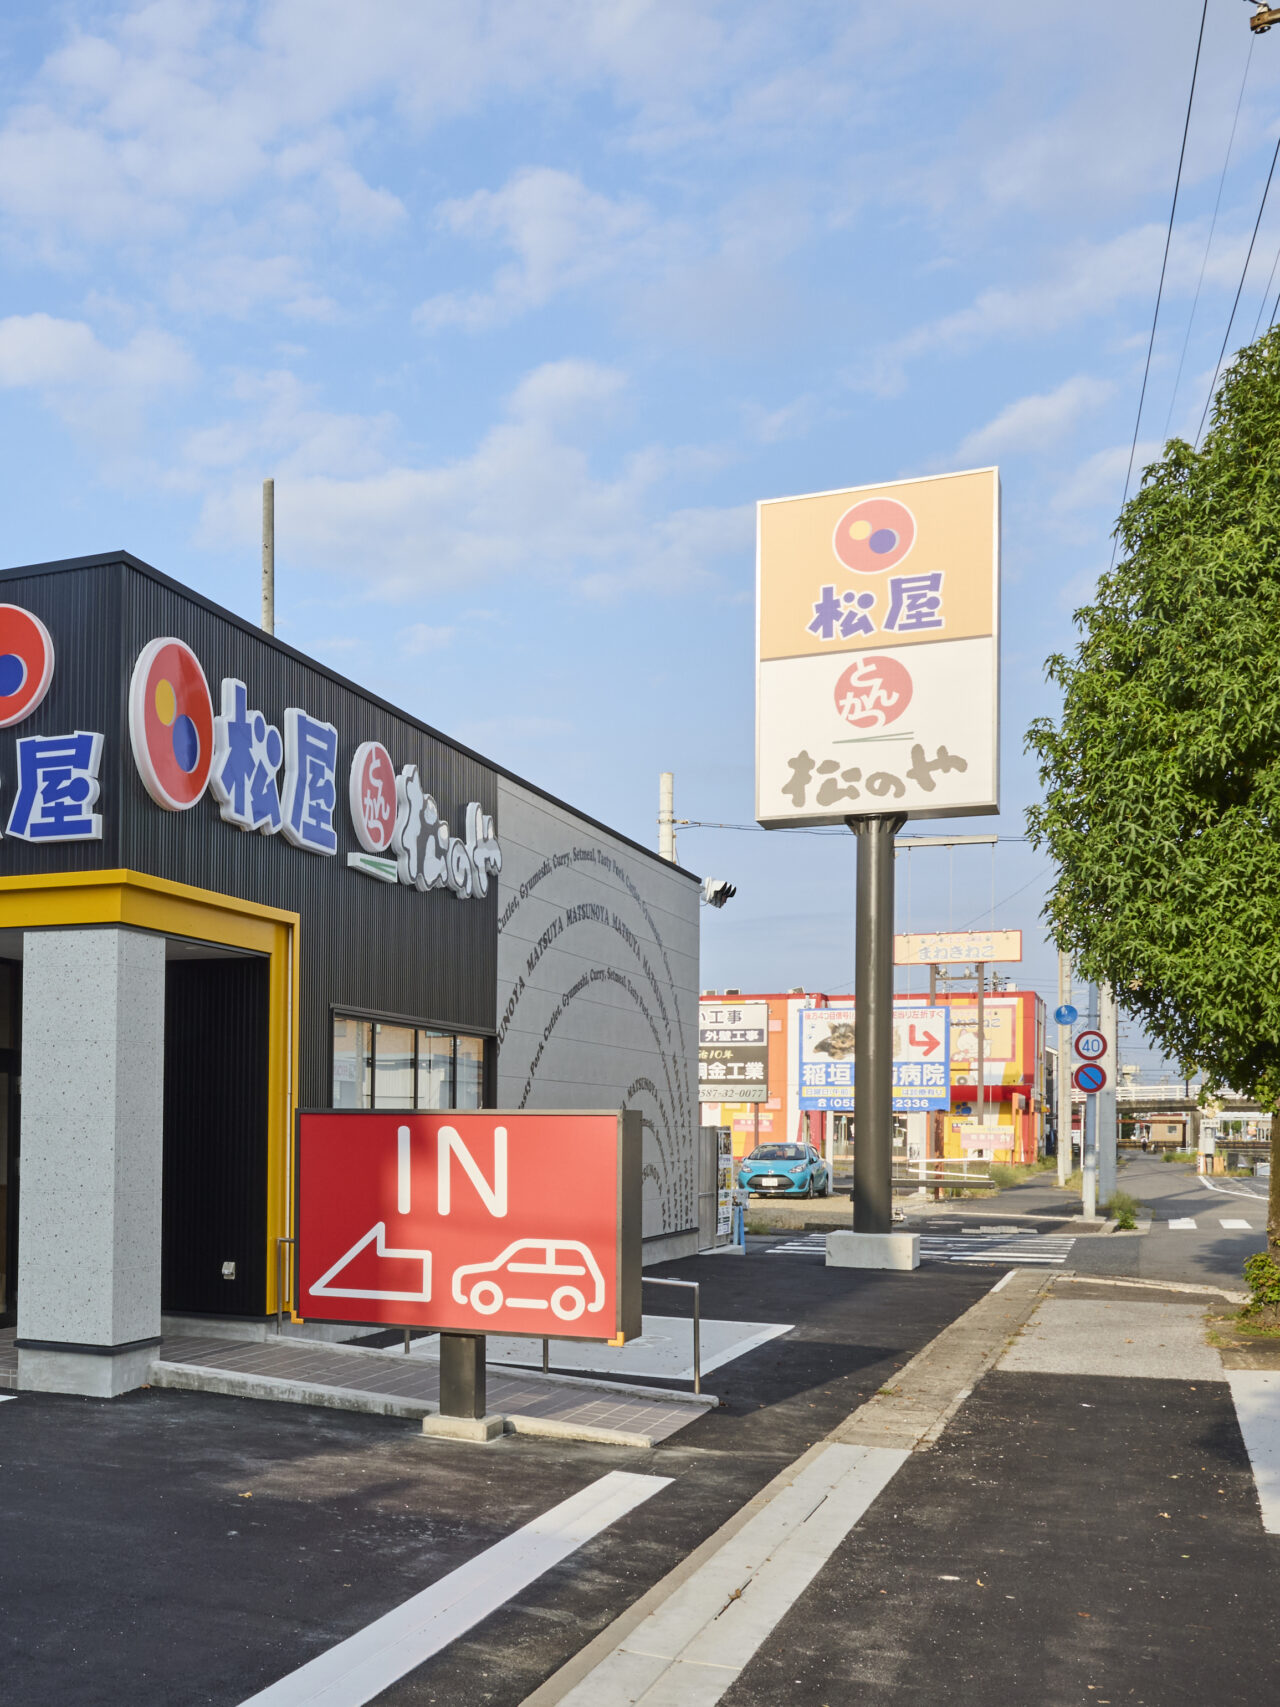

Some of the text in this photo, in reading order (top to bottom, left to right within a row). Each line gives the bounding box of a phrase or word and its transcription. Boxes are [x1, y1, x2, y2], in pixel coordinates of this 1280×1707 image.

[807, 572, 944, 639] 松屋
[214, 679, 337, 855] 松屋
[782, 744, 968, 807] 松のや
[394, 764, 502, 899] 松のや
[526, 915, 564, 977] MATSUYA
[566, 902, 610, 928] MATSUNOYA
[612, 912, 641, 962] MATSUYA
[919, 945, 995, 960] まねきねこ
[1082, 1038, 1101, 1054] 40
[699, 1088, 764, 1098] 587-32-0077
[398, 1126, 508, 1218] IN
